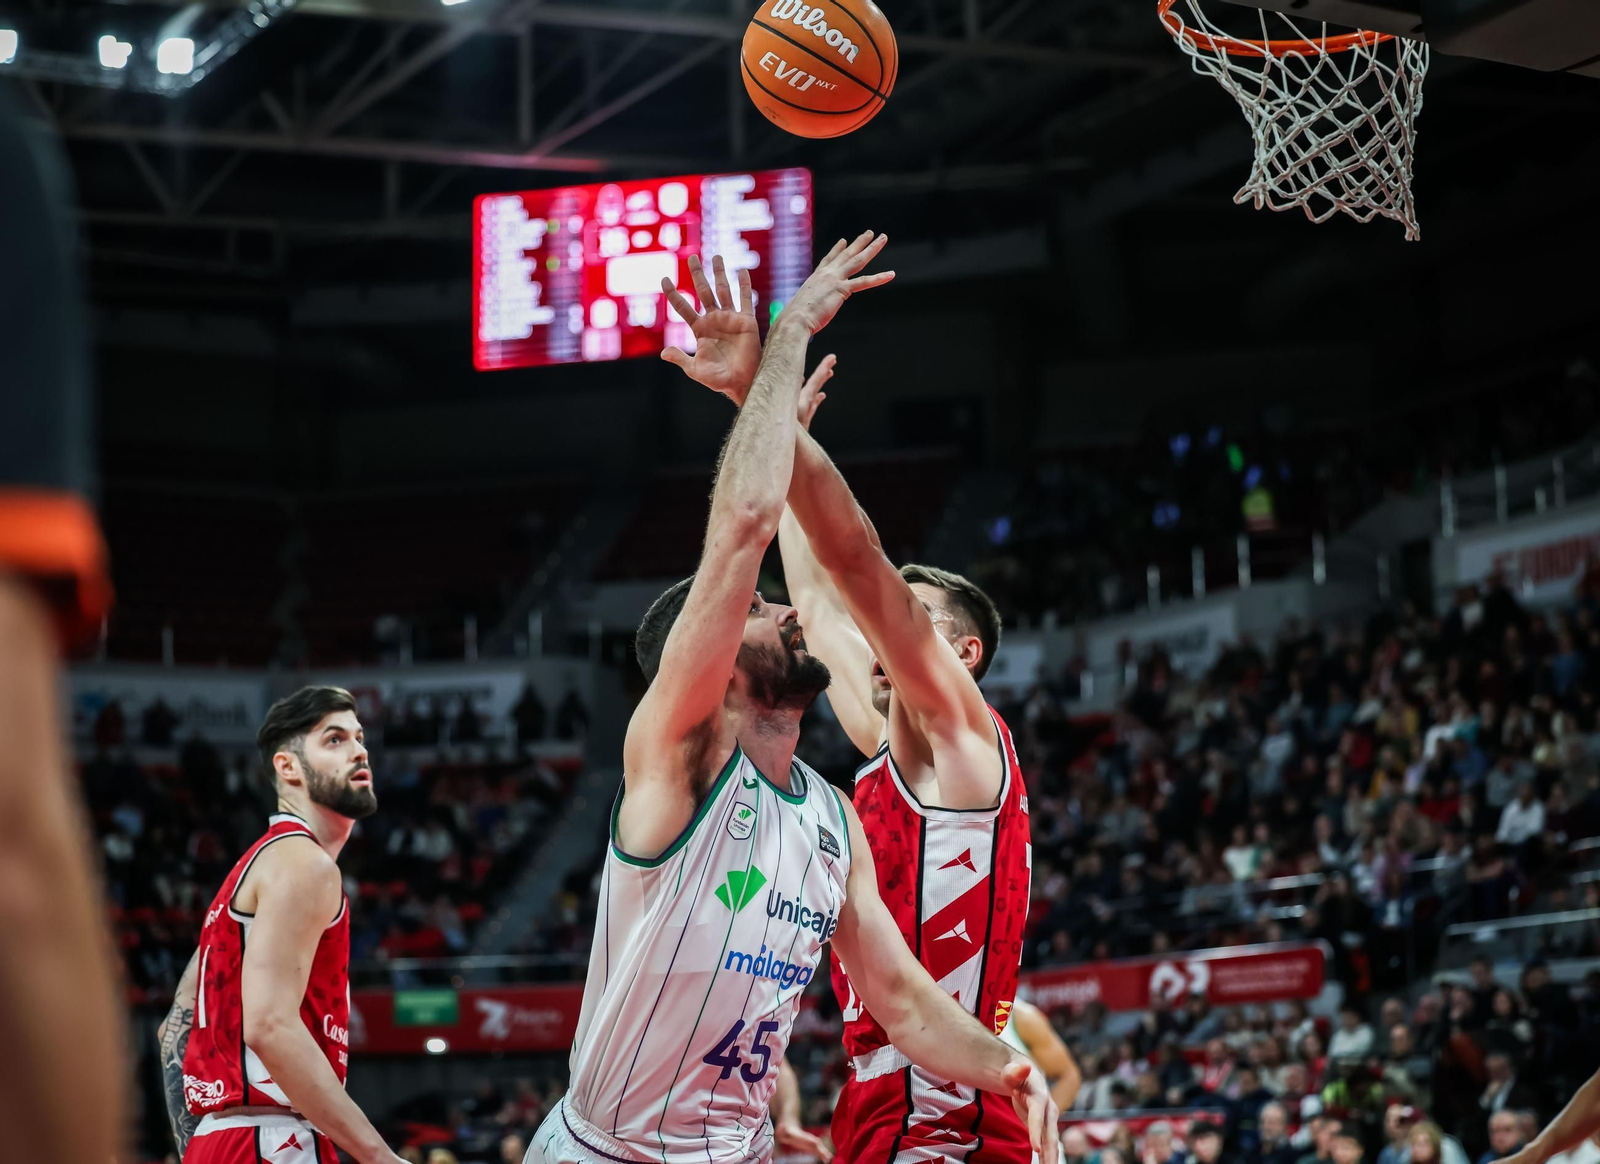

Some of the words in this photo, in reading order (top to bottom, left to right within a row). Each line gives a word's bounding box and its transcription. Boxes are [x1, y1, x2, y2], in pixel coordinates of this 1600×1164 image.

[770, 0, 859, 64] Wilson
[724, 944, 814, 990] málaga
[702, 1019, 779, 1083] 45
